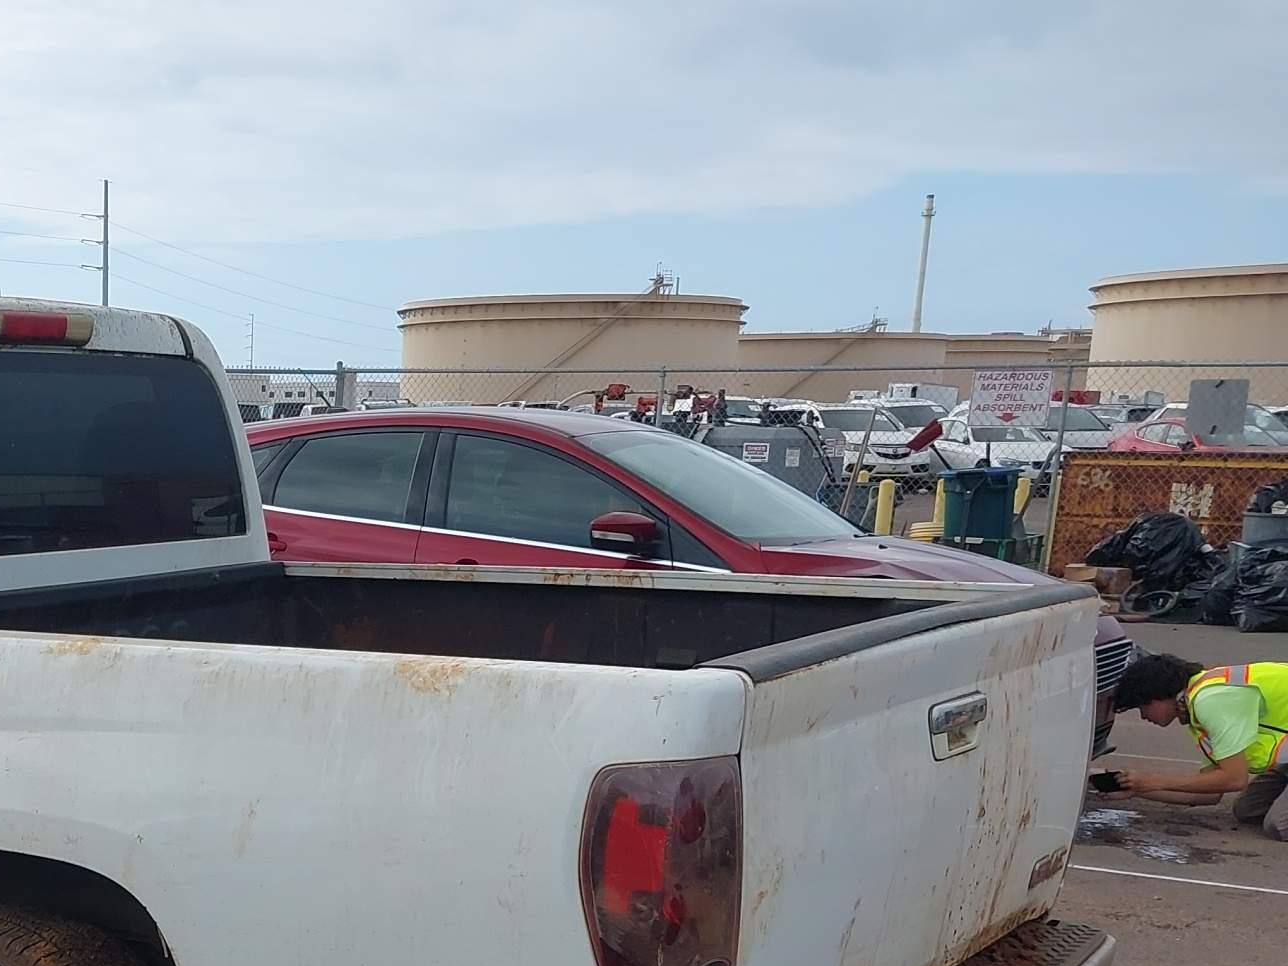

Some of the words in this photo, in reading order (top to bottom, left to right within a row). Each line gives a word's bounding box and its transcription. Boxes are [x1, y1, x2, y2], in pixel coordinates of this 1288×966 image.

[978, 372, 1050, 381] HAZARDOUS
[980, 382, 1044, 391] MATERIALS
[994, 393, 1025, 402] SPILL
[974, 403, 1045, 412] ABSORBENT
